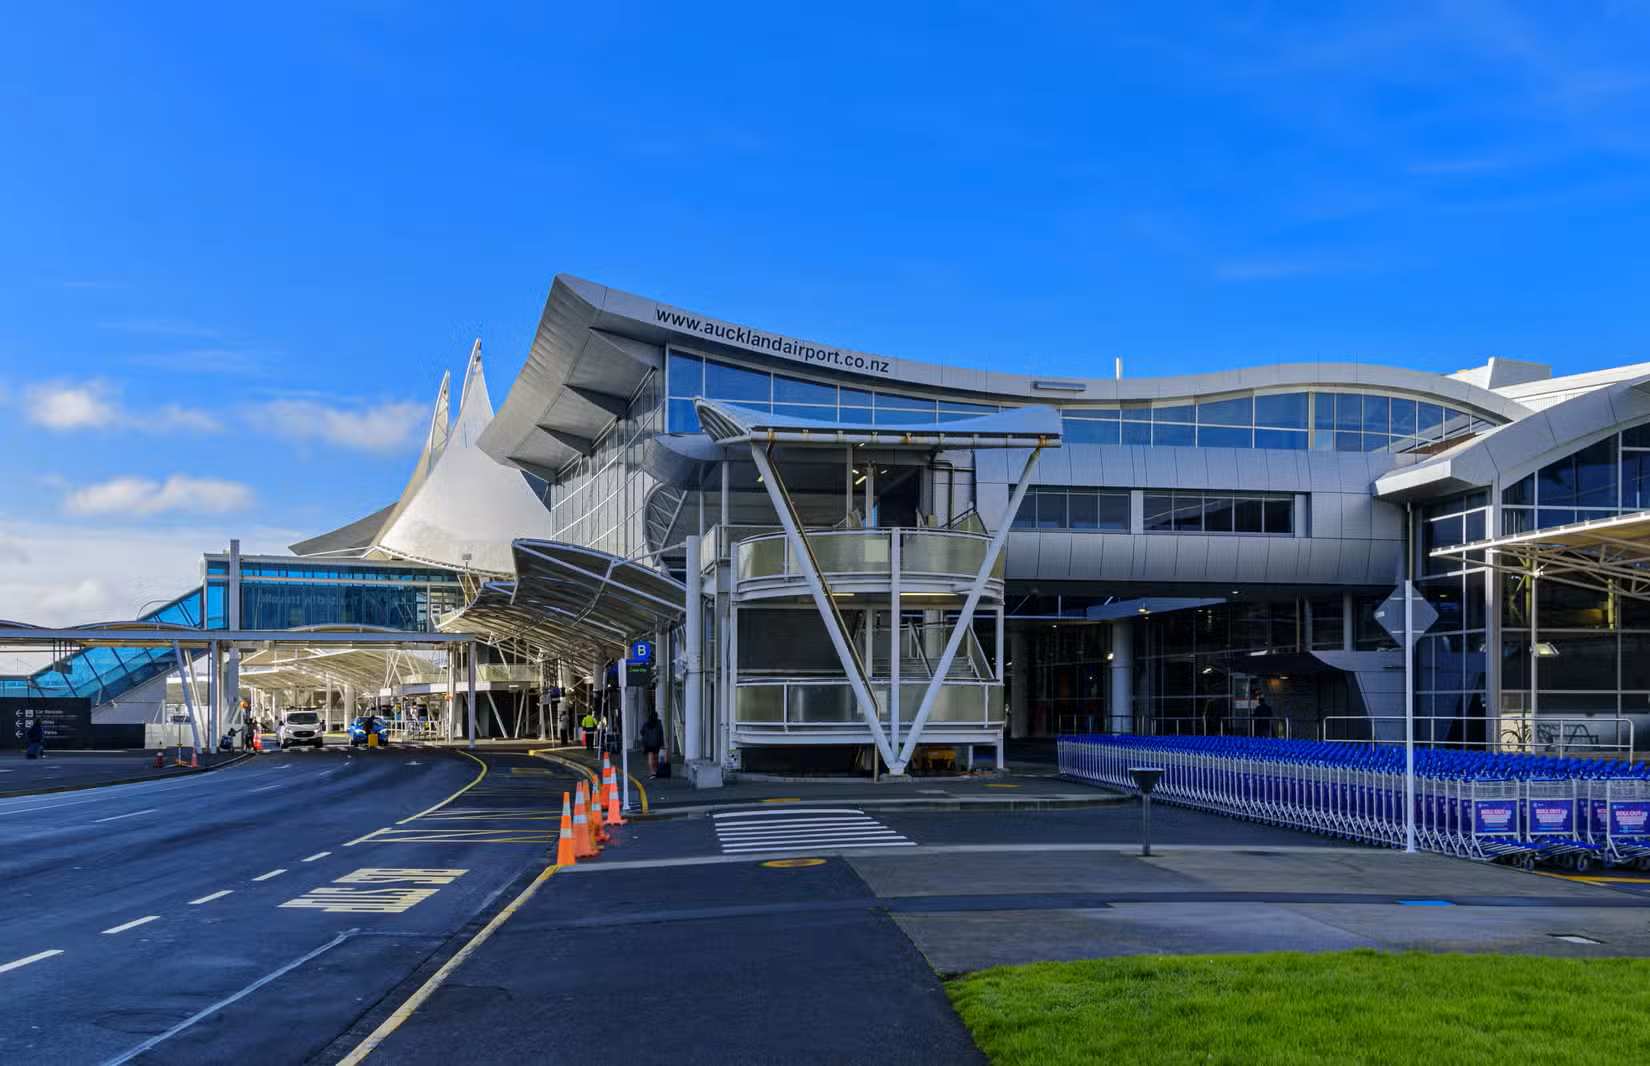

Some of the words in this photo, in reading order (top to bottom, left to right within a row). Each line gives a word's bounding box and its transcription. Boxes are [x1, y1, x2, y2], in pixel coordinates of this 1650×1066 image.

[656, 308, 890, 373] www.aucklandairport.co.nz
[637, 644, 647, 656] B
[331, 867, 470, 885] BUS
[277, 887, 441, 913] STOP
